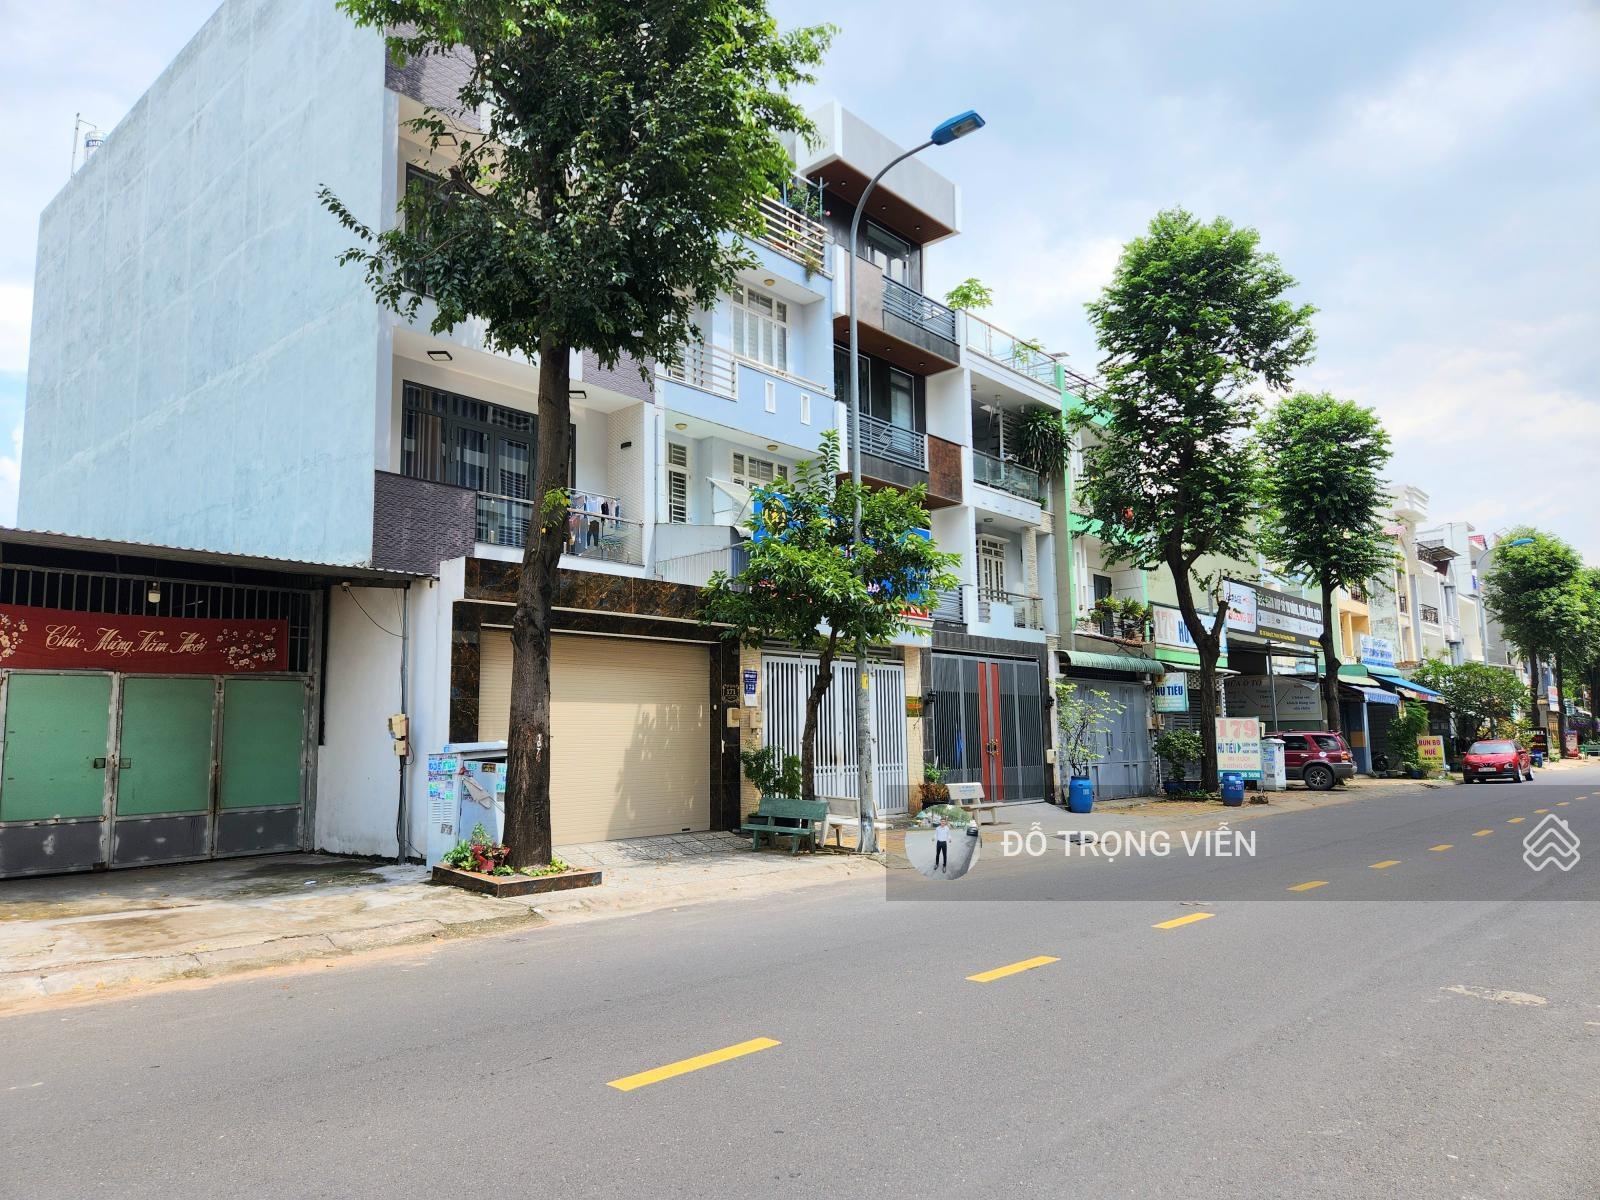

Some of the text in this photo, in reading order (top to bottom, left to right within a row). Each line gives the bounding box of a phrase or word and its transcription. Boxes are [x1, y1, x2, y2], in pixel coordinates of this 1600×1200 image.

[46, 625, 85, 650] Chúc
[132, 630, 169, 652] Năm
[1218, 720, 1257, 739] 179
